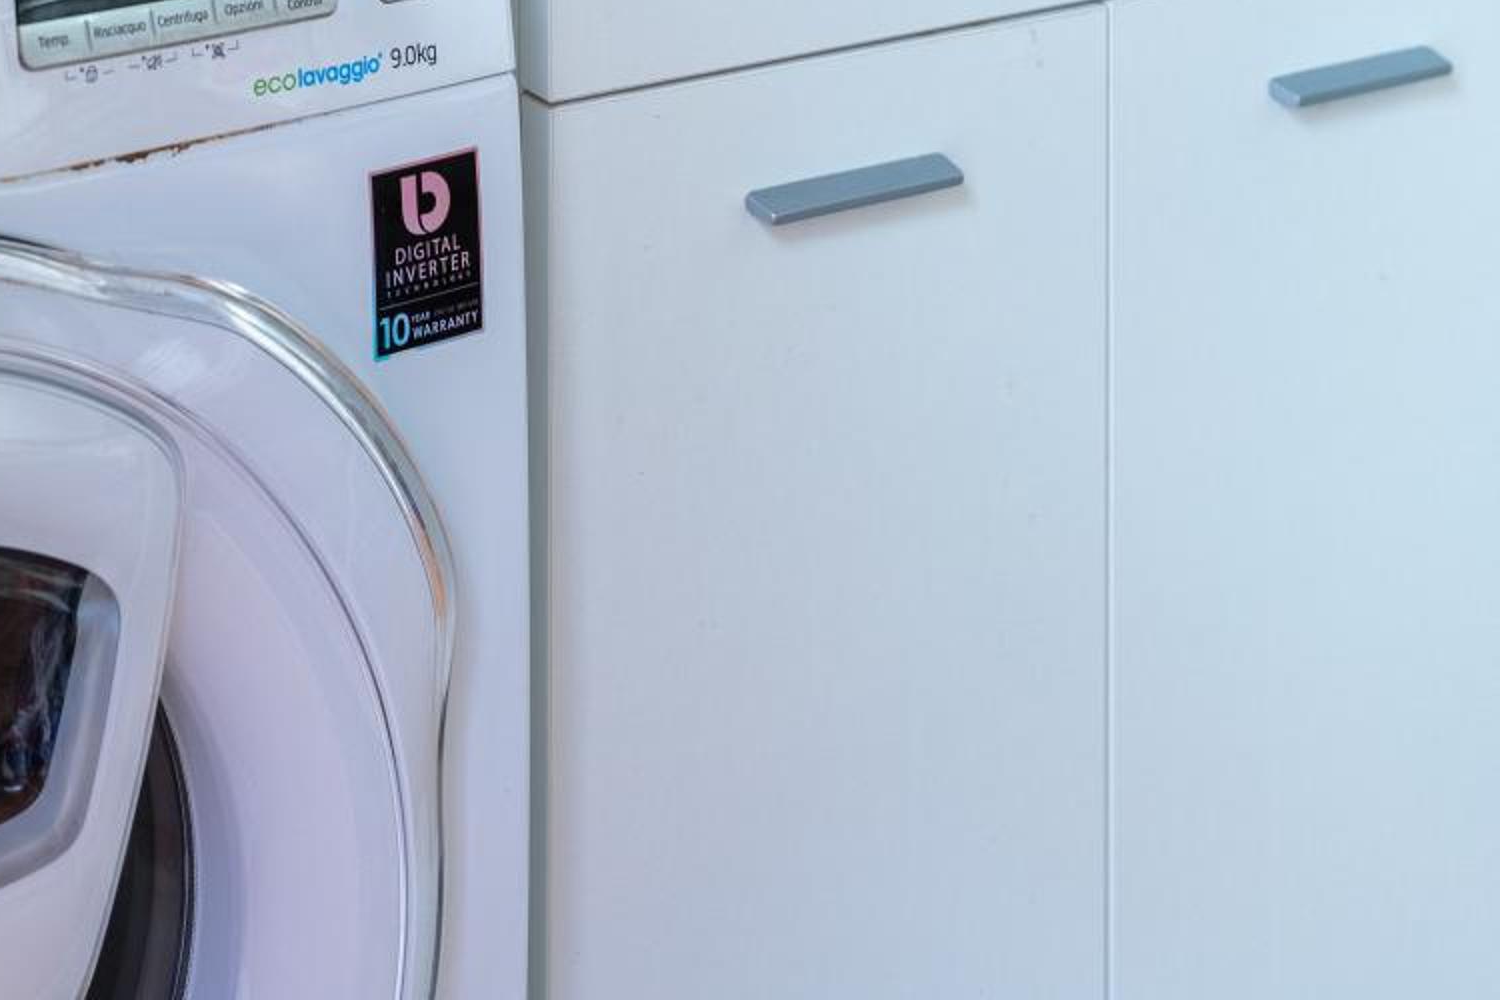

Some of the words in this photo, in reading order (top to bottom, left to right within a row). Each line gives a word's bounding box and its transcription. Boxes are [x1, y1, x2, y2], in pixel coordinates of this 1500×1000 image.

[157, 9, 208, 29] Centrifuga
[224, 0, 263, 17] Opzioni
[390, 43, 437, 69] 9.0kg
[395, 233, 461, 265] DIGITAL
[385, 251, 471, 289] INVERTER
[380, 312, 410, 349] 10
[412, 309, 479, 340] WARRANTY
